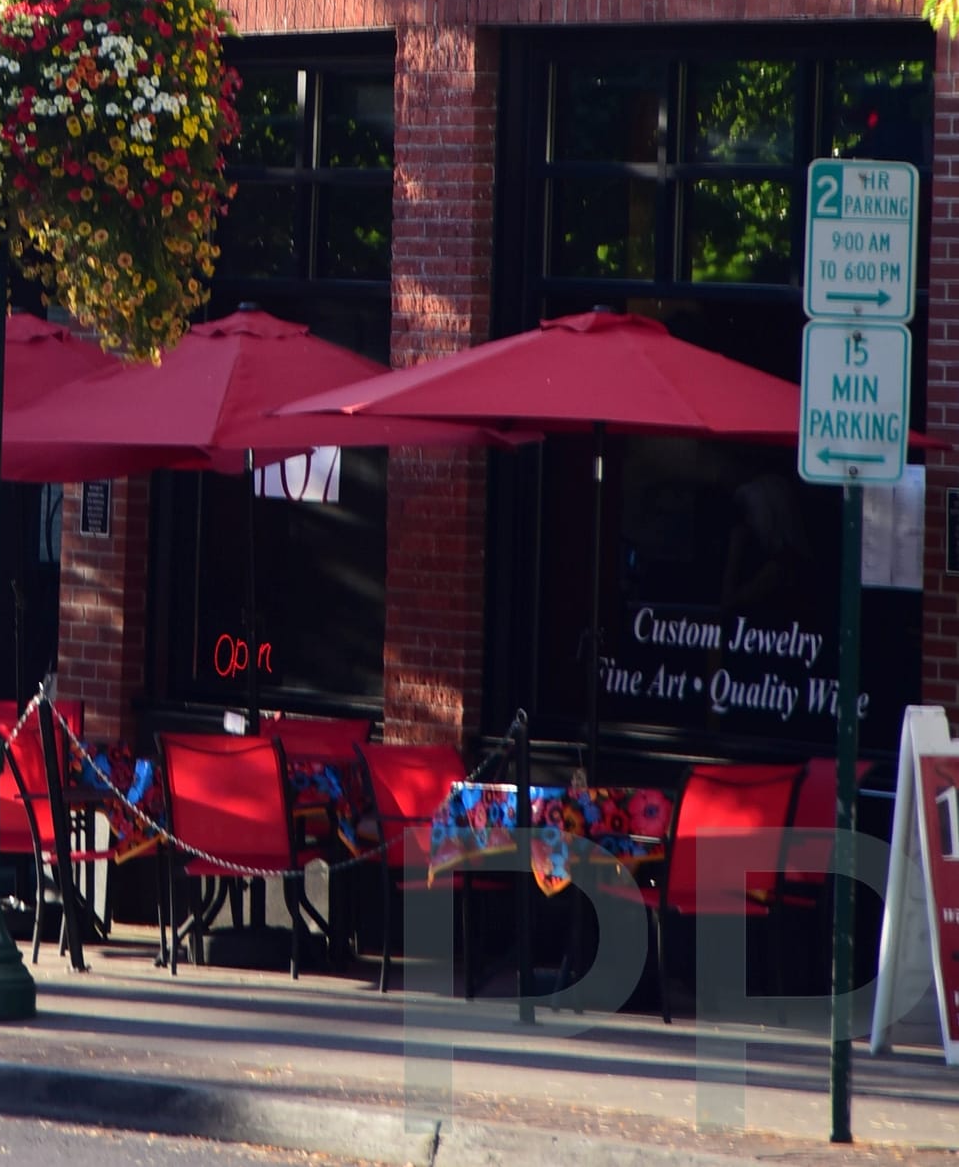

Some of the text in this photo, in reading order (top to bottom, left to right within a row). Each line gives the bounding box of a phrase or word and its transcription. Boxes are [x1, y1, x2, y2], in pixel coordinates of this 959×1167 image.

[816, 171, 890, 216] 2 HR
[844, 195, 909, 217] PARKING
[832, 231, 890, 252] 9:00 AM
[819, 259, 901, 282] TO 6:00 PM
[844, 336, 869, 366] 15
[832, 376, 879, 404] MIN
[809, 409, 899, 443] PARKING
[634, 607, 823, 668] Custom Jewelry
[214, 634, 272, 679] Opn
[647, 664, 687, 700] Art
[710, 668, 799, 720] Quality
[808, 677, 869, 718] Wie
